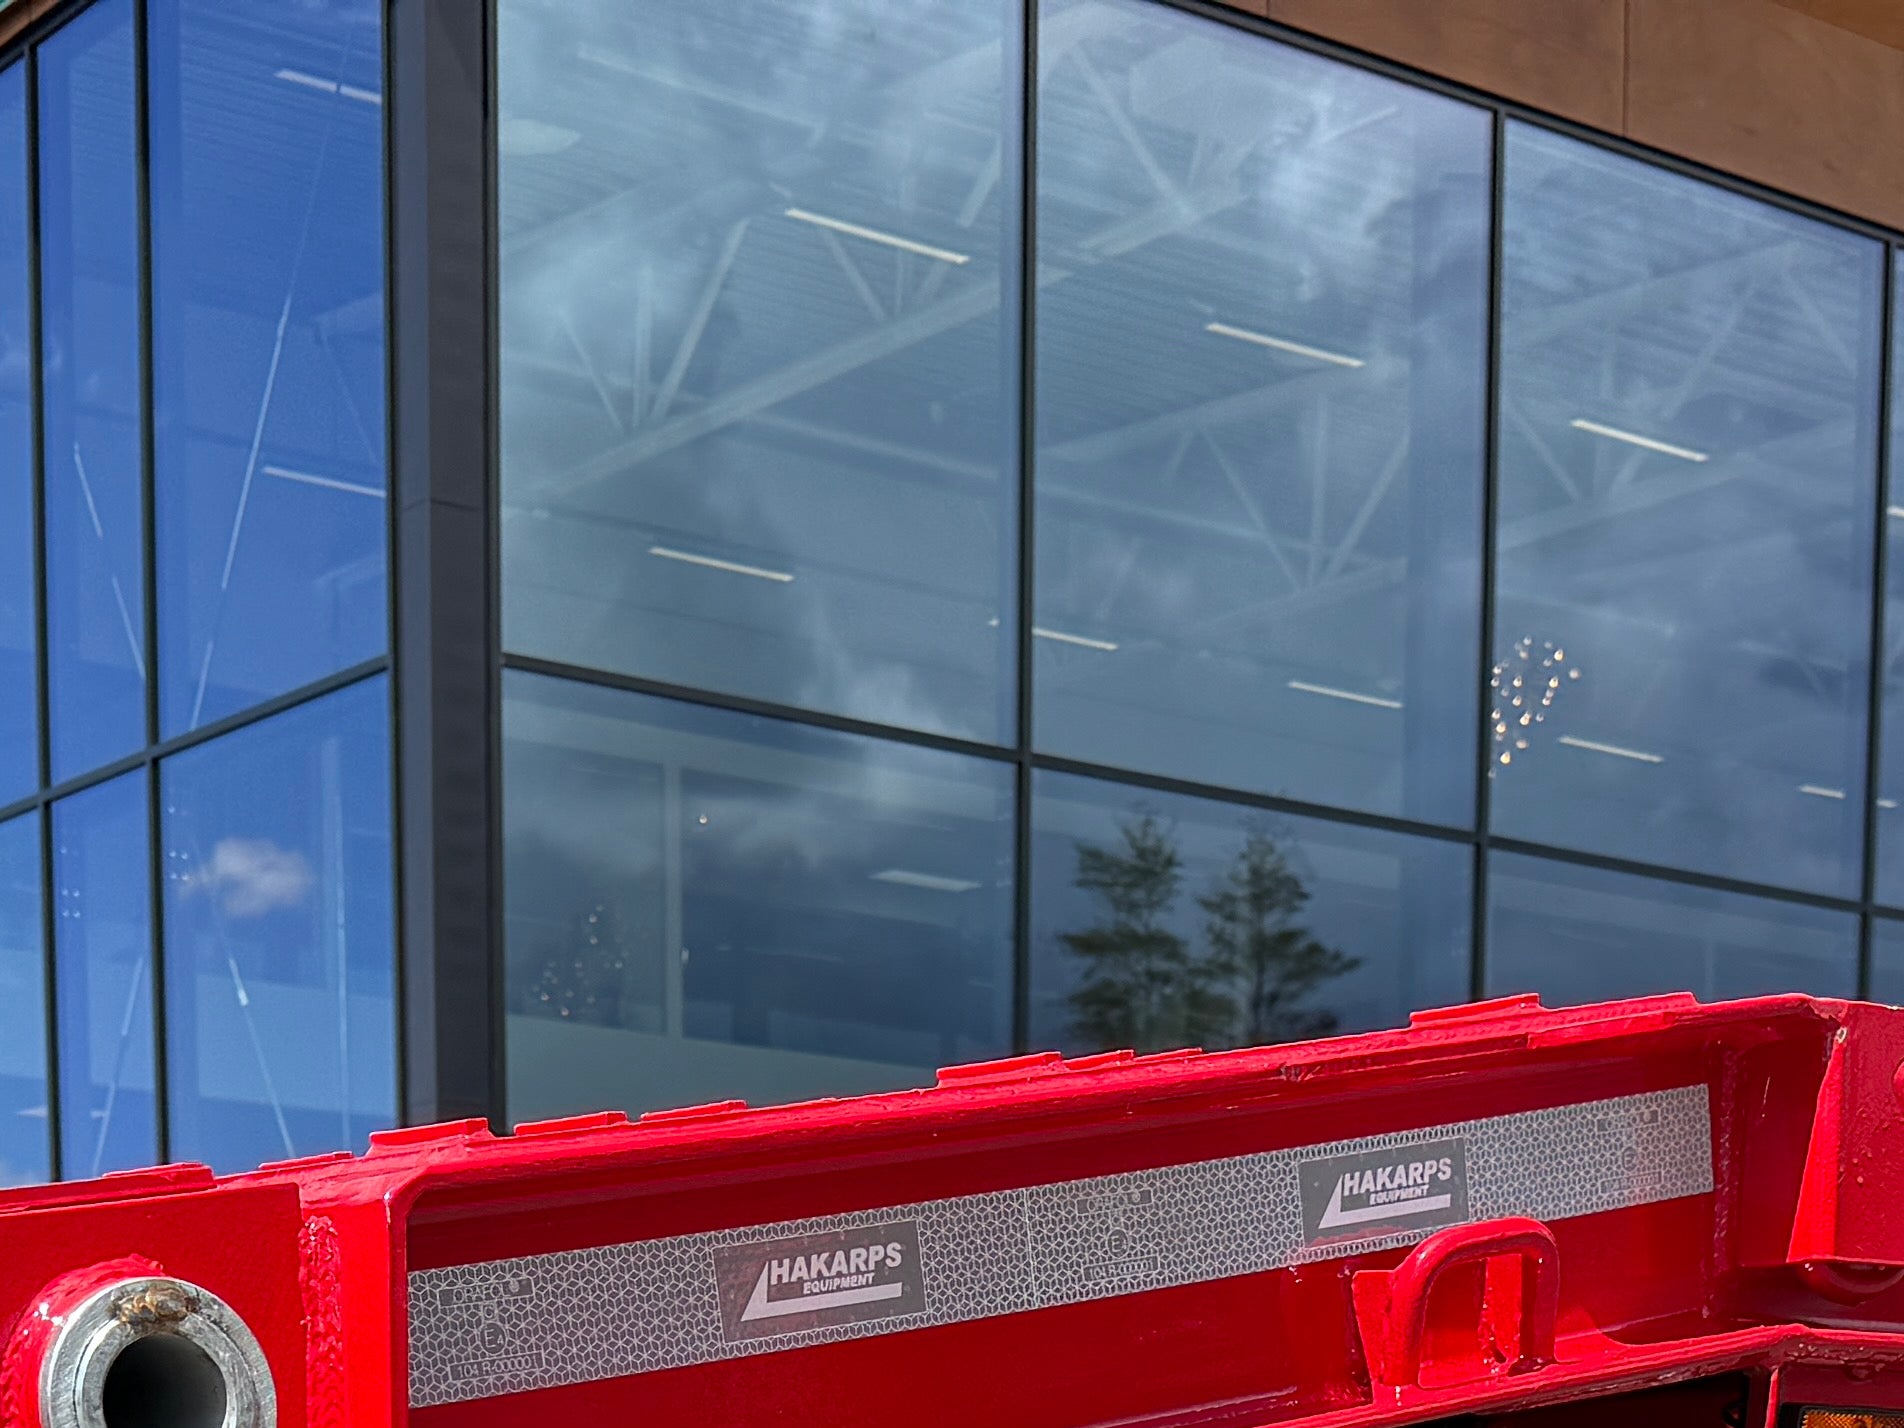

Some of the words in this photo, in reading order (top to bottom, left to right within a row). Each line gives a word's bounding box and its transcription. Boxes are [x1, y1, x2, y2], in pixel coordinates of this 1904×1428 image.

[1343, 1158, 1452, 1196] HAKARPS
[1369, 1185, 1429, 1205] EQUIPMENT
[769, 1242, 903, 1285] HAKARPS
[803, 1273, 876, 1294] EQUIPMENT
